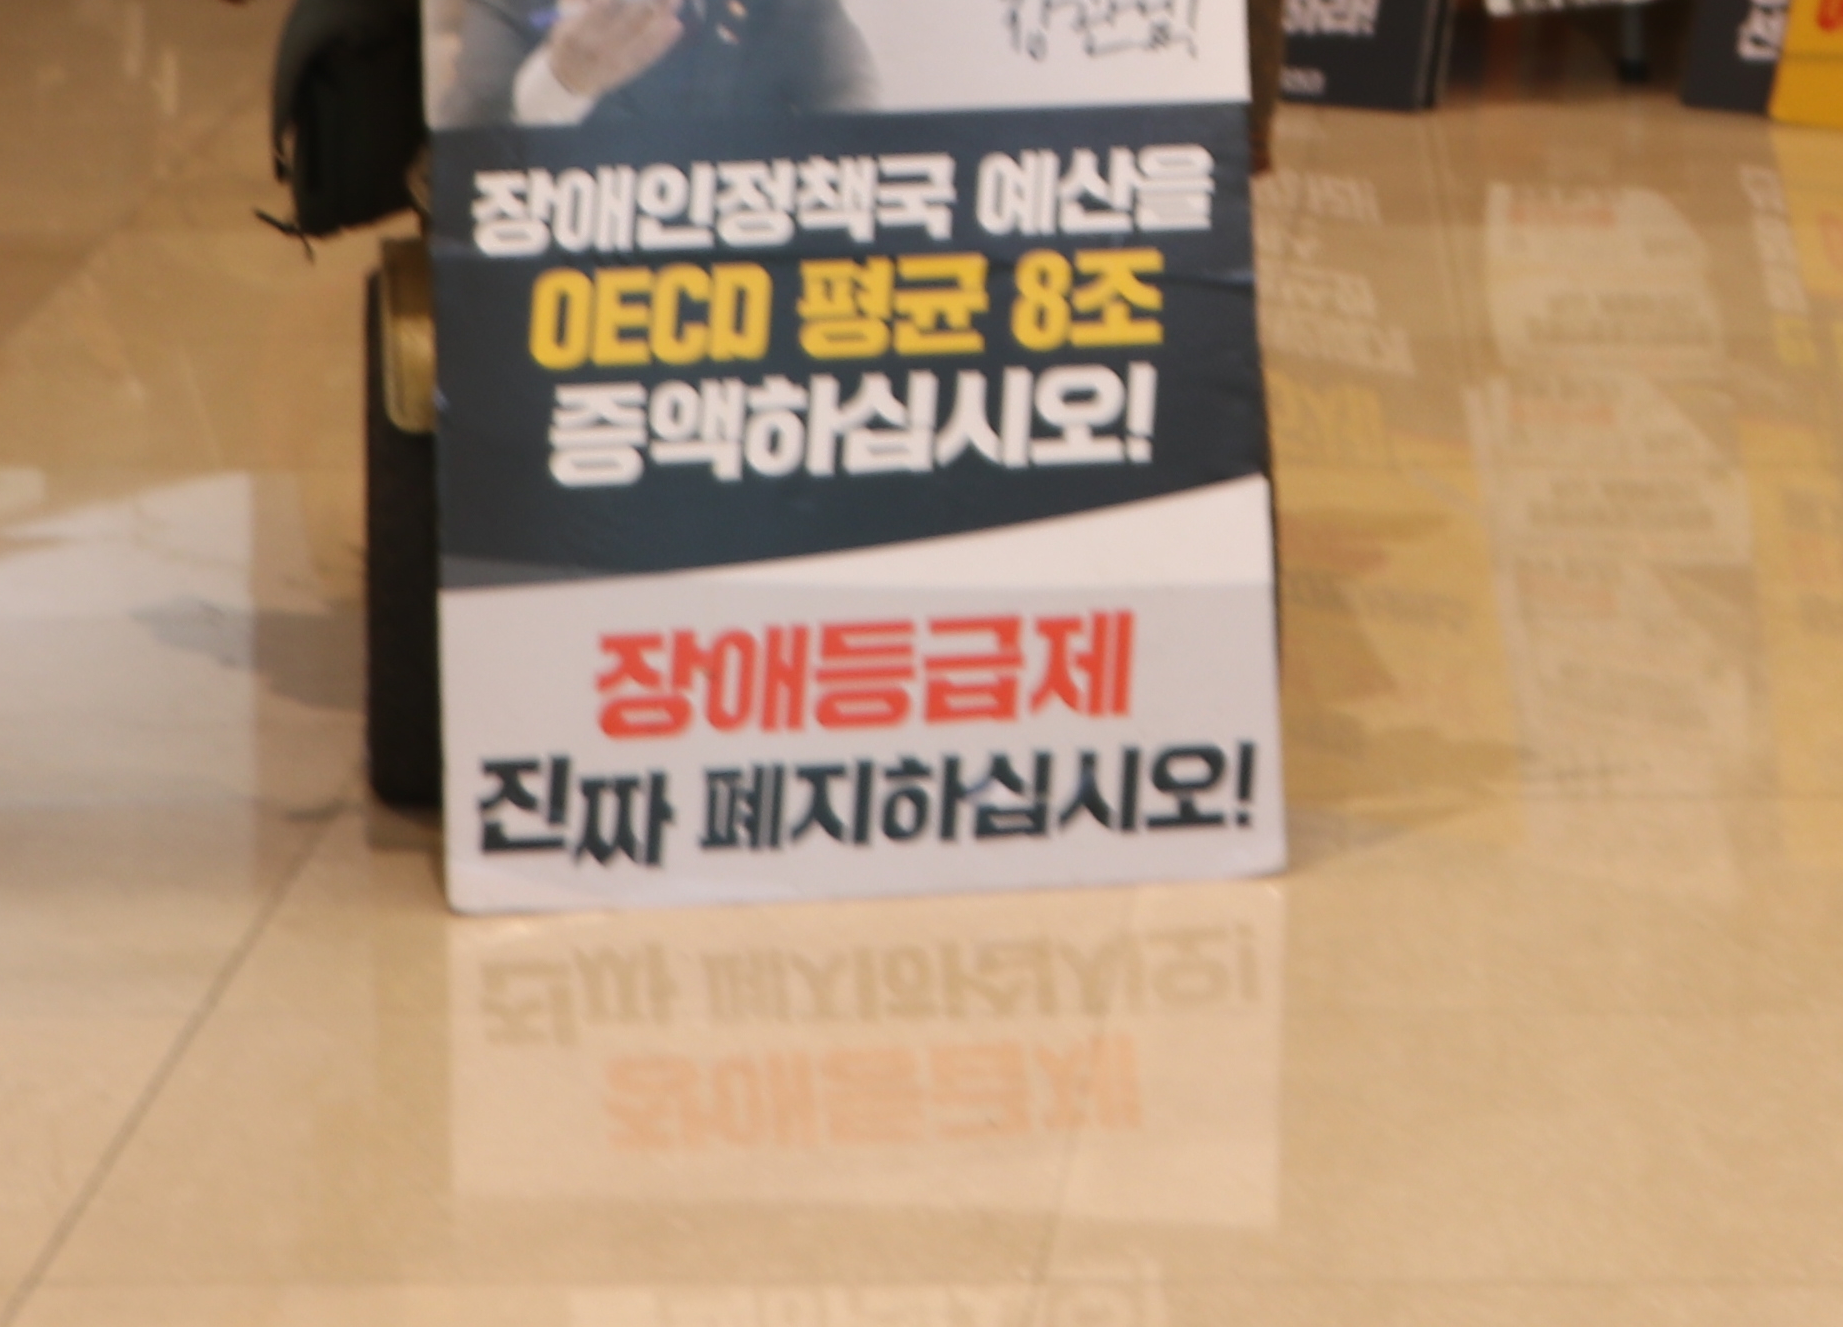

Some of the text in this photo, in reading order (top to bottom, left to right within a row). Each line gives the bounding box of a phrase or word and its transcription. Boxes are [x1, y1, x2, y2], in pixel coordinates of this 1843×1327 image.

[471, 144, 1217, 261] 장애인정책국 예산을
[527, 244, 1164, 371] OECD 평균 8조
[546, 362, 1156, 490] 증액하십시오!
[595, 610, 1134, 741] 장애등급제
[477, 740, 1256, 869] 진짜 폐지하십시오!
